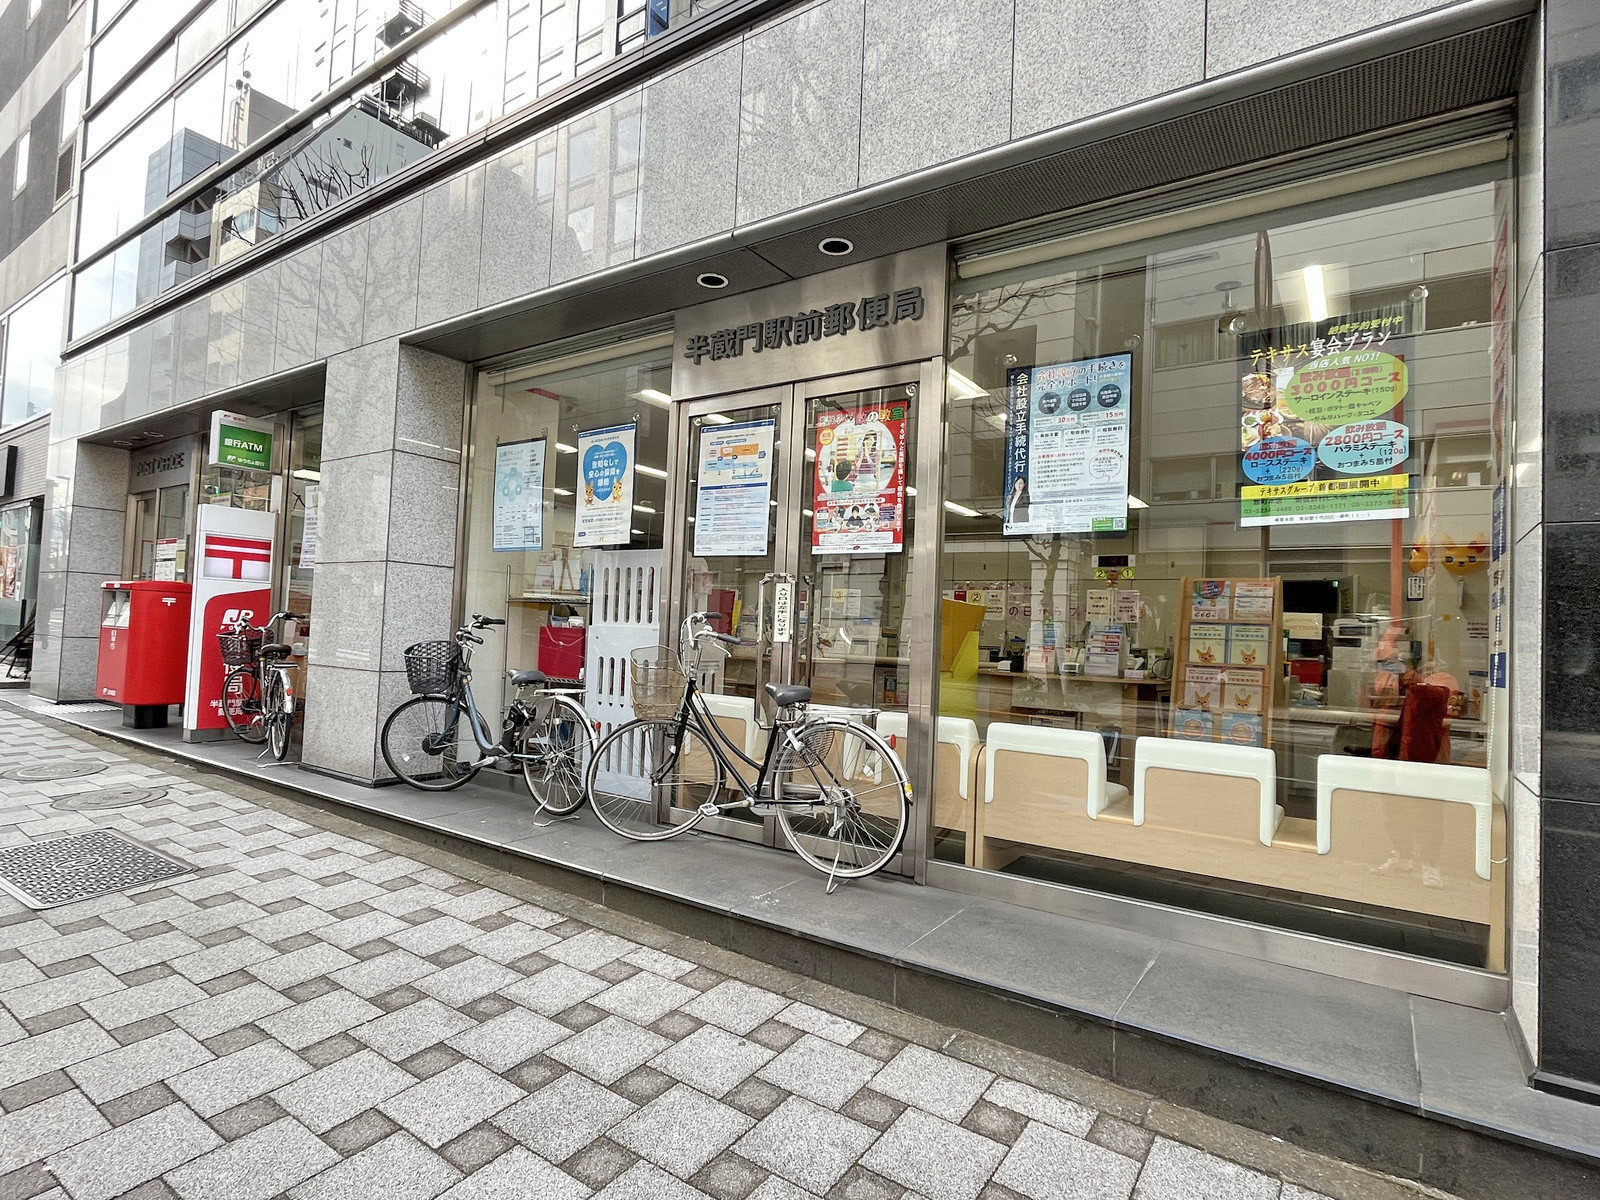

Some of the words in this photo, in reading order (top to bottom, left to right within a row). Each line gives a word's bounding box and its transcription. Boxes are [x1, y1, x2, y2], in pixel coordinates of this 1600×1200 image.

[684, 286, 924, 366] 半蔵門駅前郵便局
[1250, 330, 1392, 366] テキサス宴会プラン
[1037, 361, 1126, 381] 会社設立の手続きを
[1308, 356, 1351, 370] 当店人気
[1036, 375, 1097, 392] 完全サポート!
[1290, 372, 1401, 397] 3000円コース
[1013, 372, 1029, 473] 会社設立手続代行
[1345, 422, 1387, 434] 飲み放題
[224, 437, 264, 453] 銀行ATM
[1324, 429, 1405, 446] 2800円コース
[1245, 448, 1312, 461] 4000円コース
[1334, 441, 1397, 453] ハラミステーキ
[591, 459, 620, 469] 告知なしで
[1250, 457, 1308, 468] ロースステーキ
[1259, 483, 1316, 496] テキサスグループ
[777, 587, 788, 636] 入り口は左手になります
